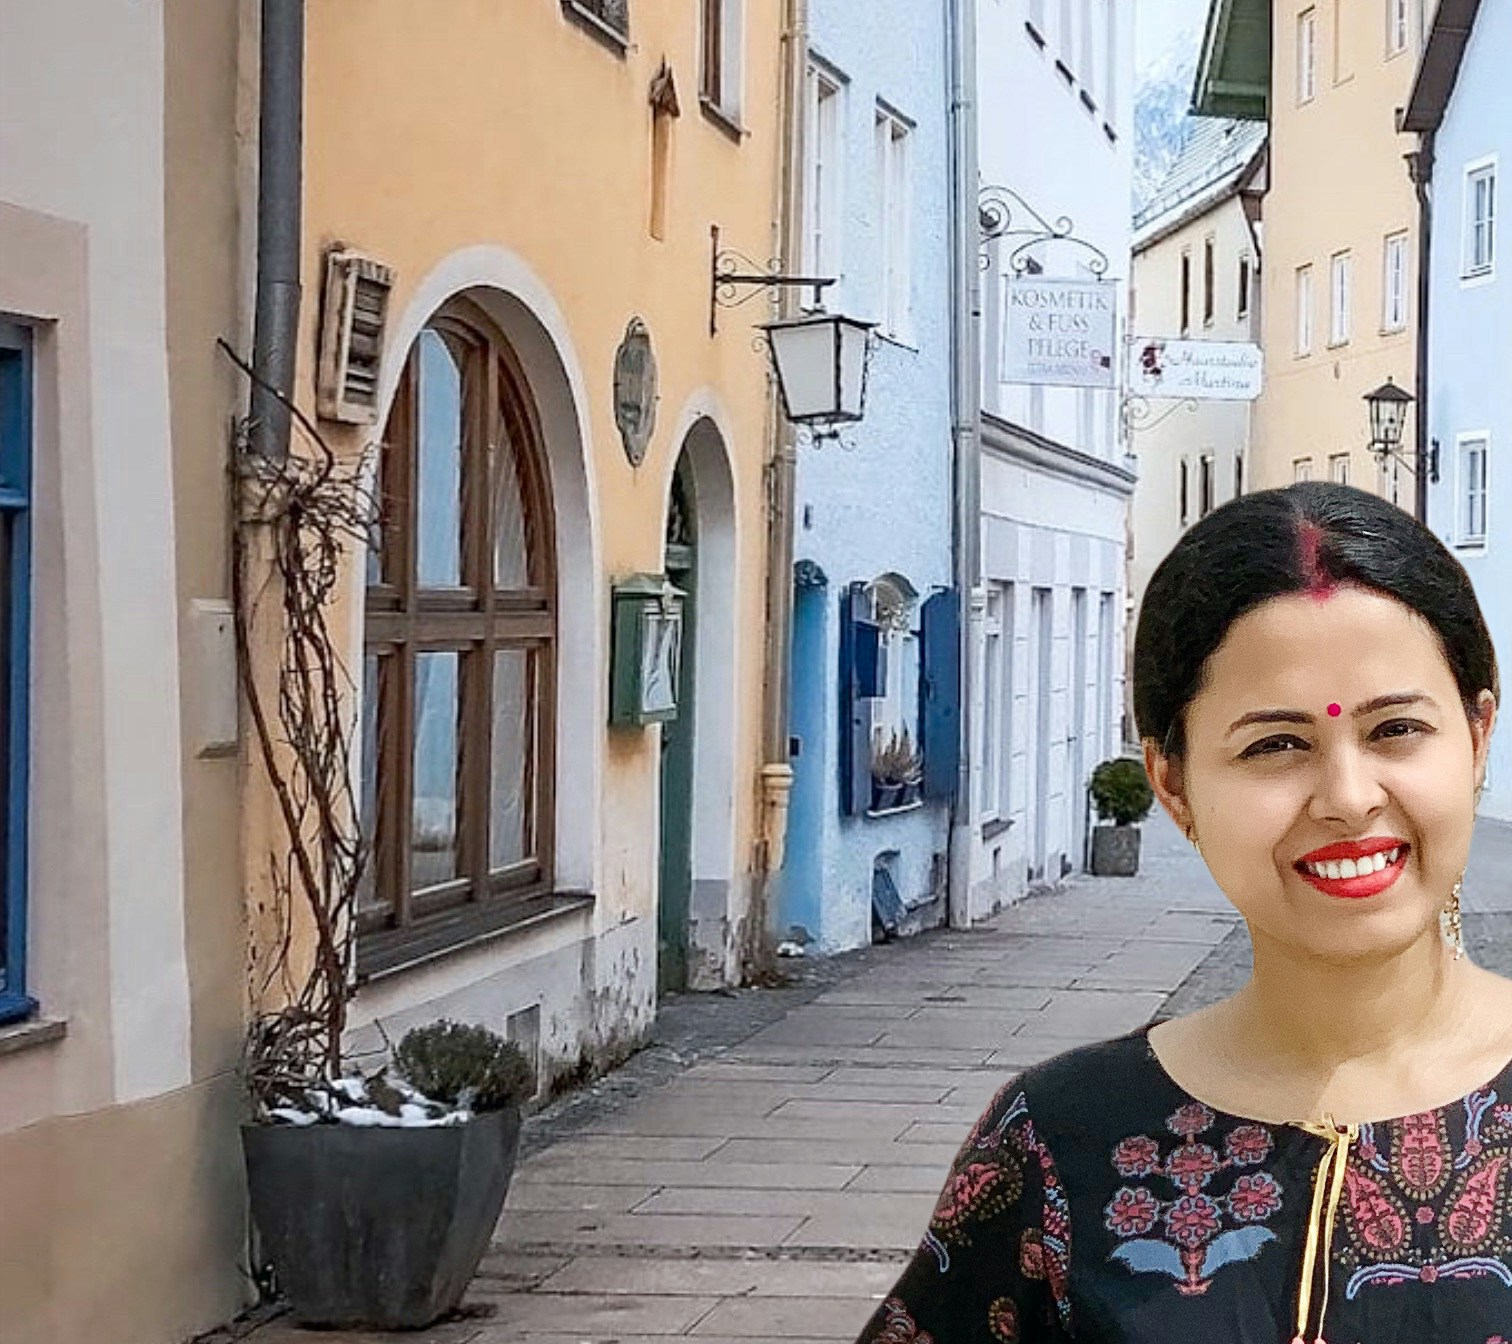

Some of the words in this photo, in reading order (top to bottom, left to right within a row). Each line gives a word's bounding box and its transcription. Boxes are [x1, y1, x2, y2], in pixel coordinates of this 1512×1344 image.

[1010, 288, 1109, 311] KOSMETIK
[1028, 312, 1043, 331] &
[1048, 313, 1090, 333] FUSS
[1027, 338, 1090, 360] PFLEGE
